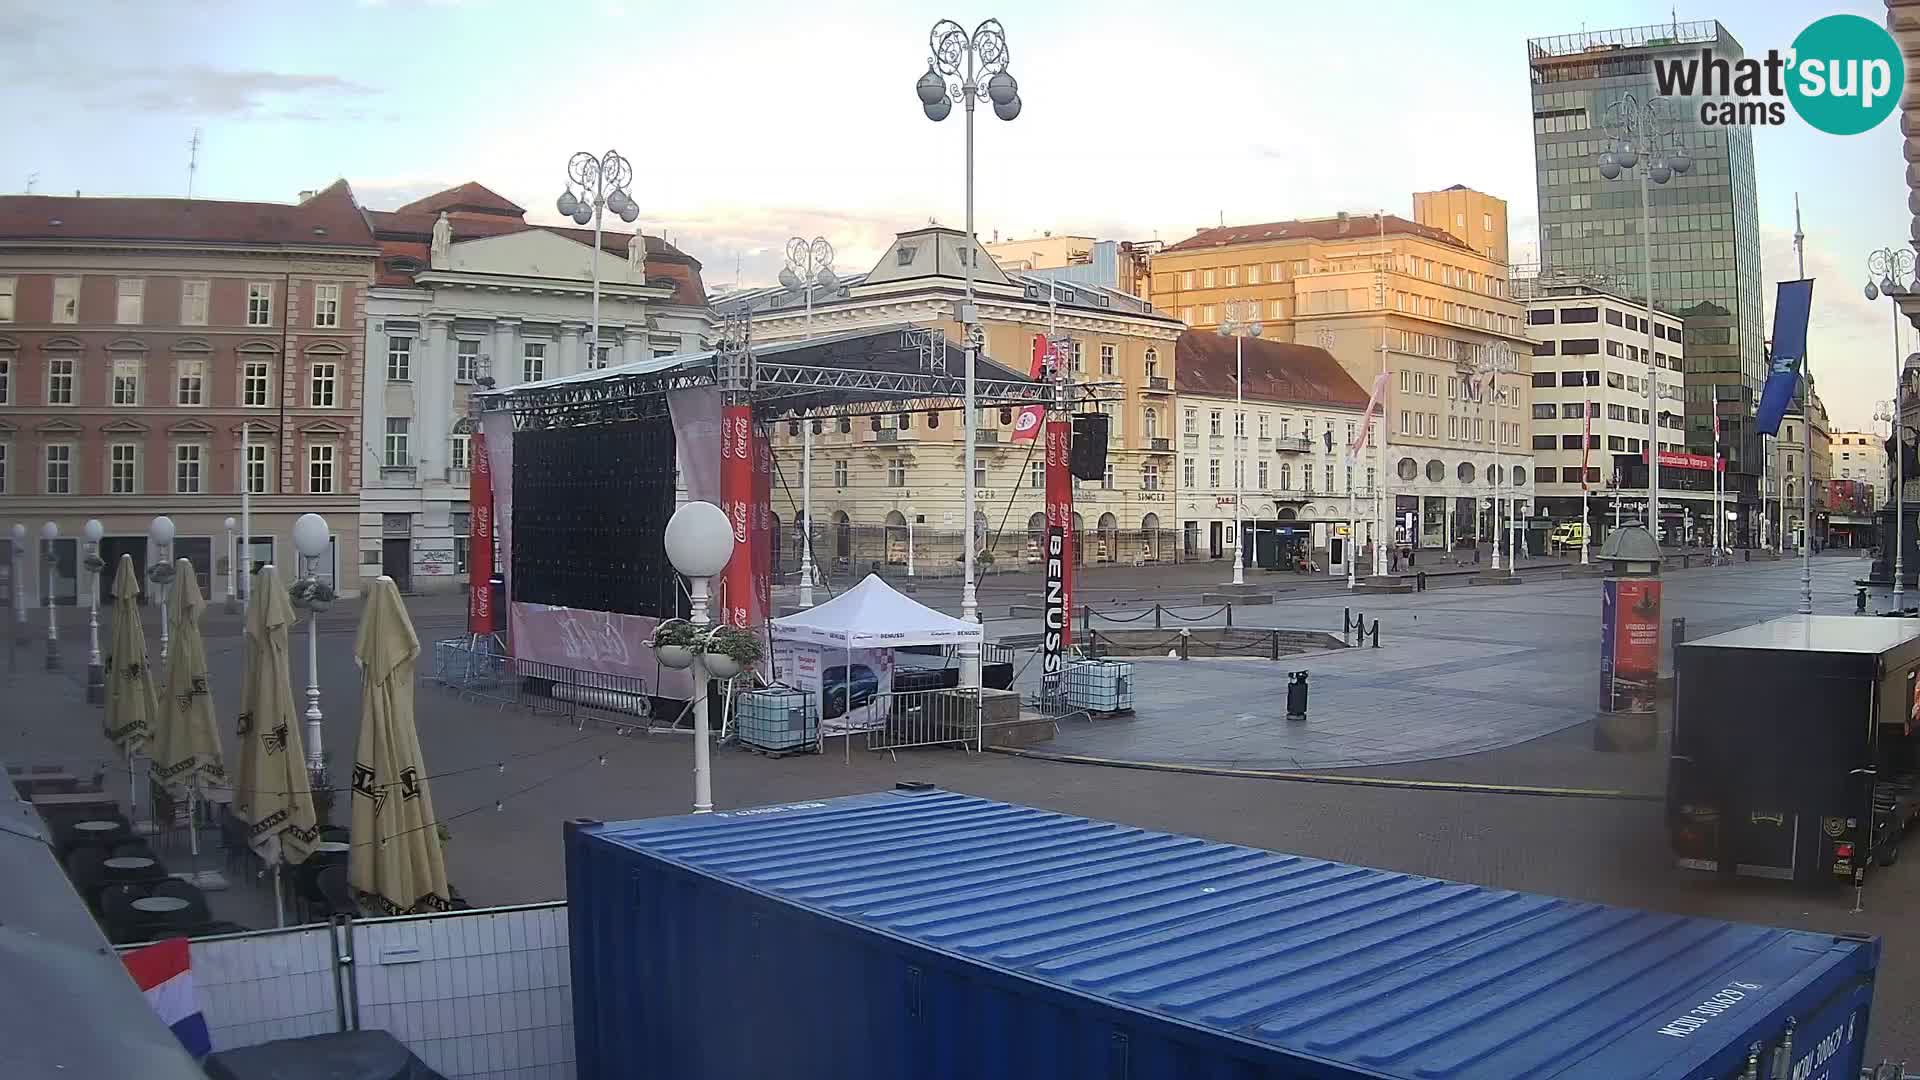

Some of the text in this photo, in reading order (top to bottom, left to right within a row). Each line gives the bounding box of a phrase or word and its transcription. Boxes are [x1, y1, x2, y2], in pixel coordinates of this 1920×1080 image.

[734, 416, 748, 459] Coca-Cola
[960, 489, 996, 500] SGER
[1137, 491, 1166, 502] SINGER
[734, 500, 747, 542] Coca-Cola
[1657, 1015, 1707, 1037] MCDU
[1690, 988, 1745, 1016] 300629
